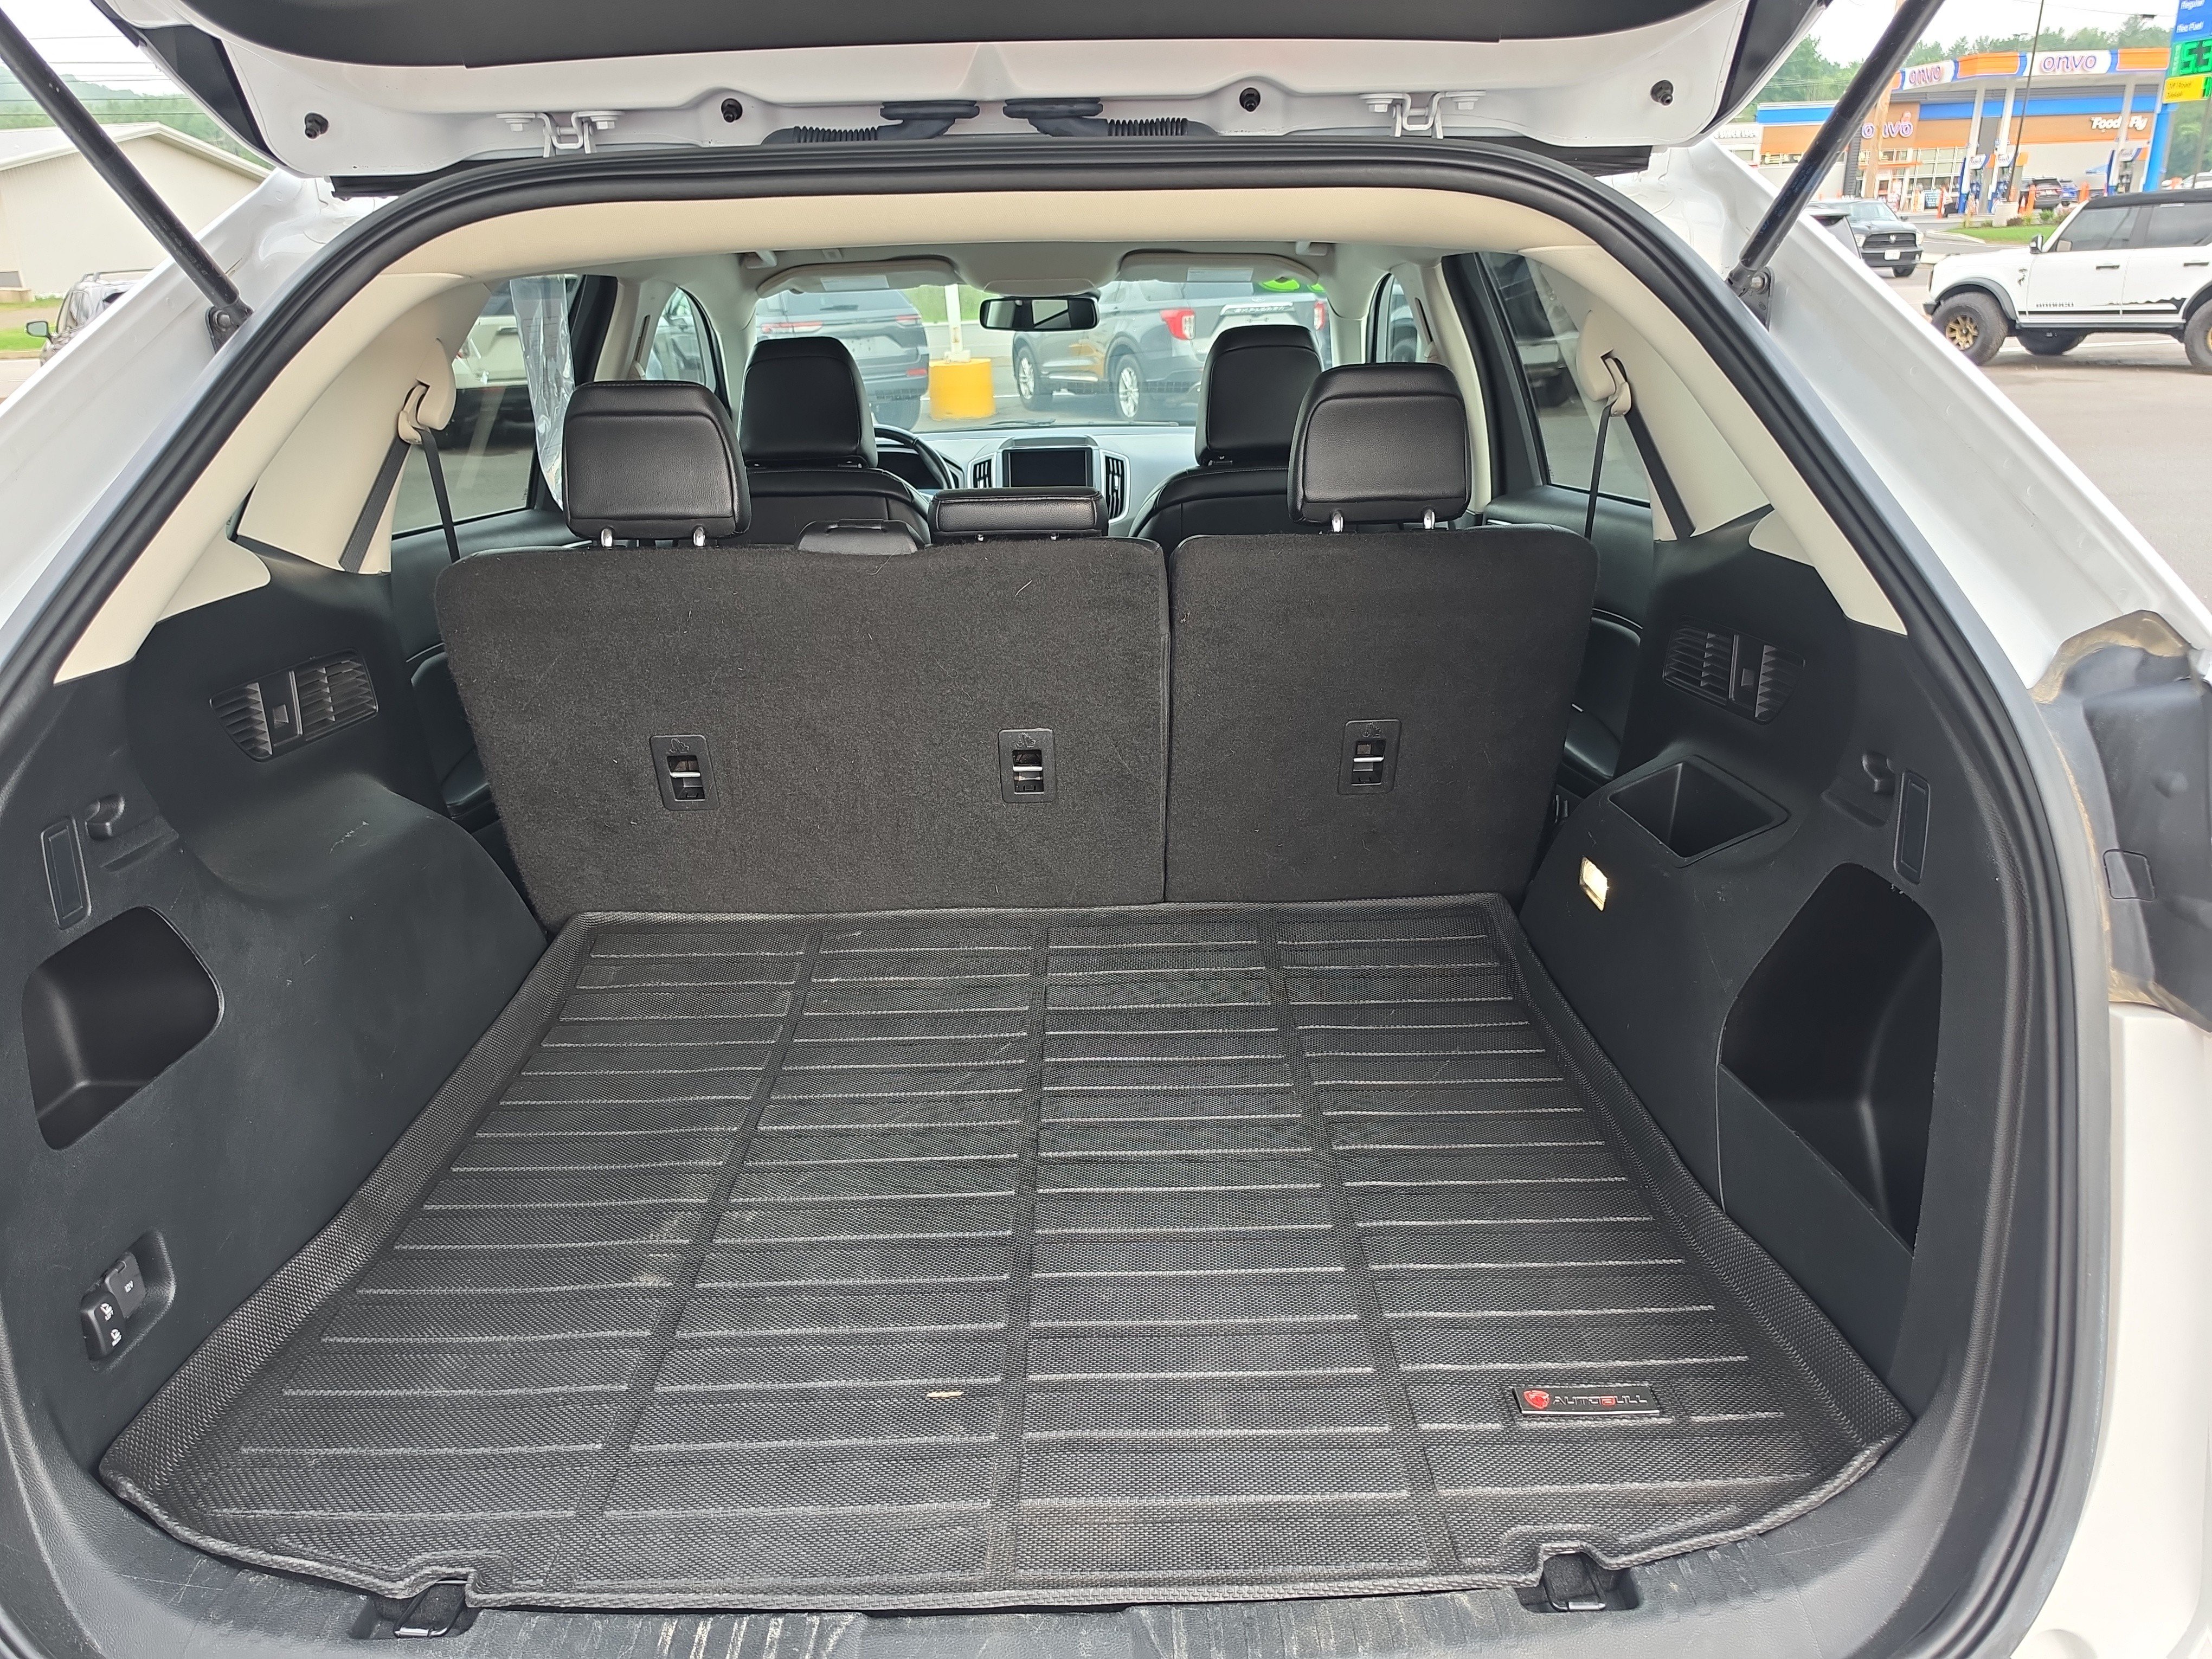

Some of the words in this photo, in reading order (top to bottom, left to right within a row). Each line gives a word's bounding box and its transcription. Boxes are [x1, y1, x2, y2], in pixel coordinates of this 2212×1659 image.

[2041, 55, 2098, 73] onvo
[1908, 65, 1943, 85] onvo
[2090, 115, 2122, 130] Food
[124, 1280, 134, 1293] 12V
[1553, 1394, 1648, 1407] AUTOBULL
